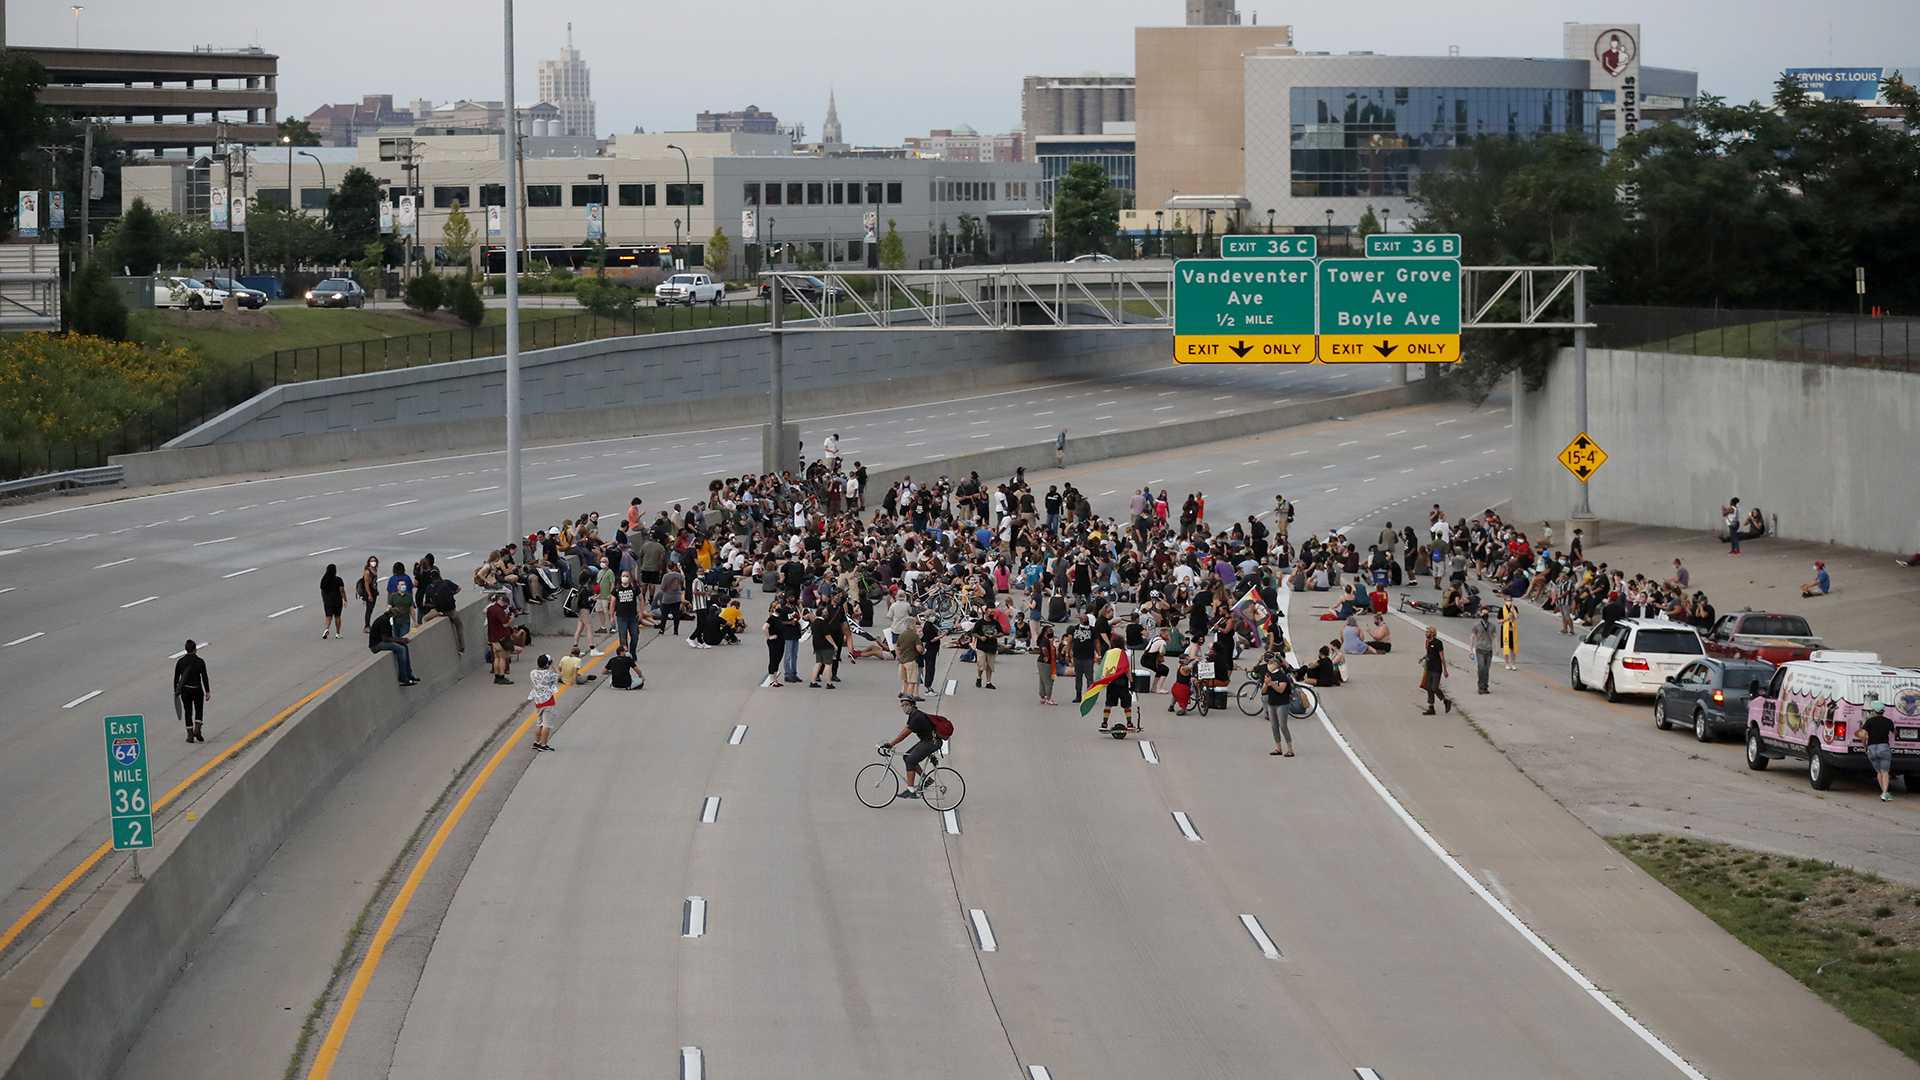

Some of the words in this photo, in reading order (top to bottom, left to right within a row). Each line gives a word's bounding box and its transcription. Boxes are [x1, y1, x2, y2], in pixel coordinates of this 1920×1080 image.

[1792, 72, 1833, 81] ERVING
[1849, 72, 1877, 81] LOUIS
[1621, 76, 1638, 134] spitals
[1230, 242, 1257, 252] EXIT
[1268, 240, 1290, 254] 36
[1296, 240, 1308, 254] C
[1374, 242, 1401, 252] EXIT
[1412, 240, 1436, 253] 36
[1442, 240, 1454, 253] B
[1182, 269, 1308, 284] Vandeventer
[1327, 268, 1385, 283] Tower
[1396, 268, 1452, 282] Grove
[1227, 291, 1263, 305] Ave
[1371, 289, 1408, 304] Ave
[1245, 314, 1273, 325] MILE
[1338, 311, 1393, 329] Boyle
[1404, 311, 1441, 325] Ave
[1188, 344, 1219, 355] EXIT
[1263, 344, 1301, 355] ONLY
[1332, 344, 1364, 355] EXIT
[1407, 343, 1445, 354] ONLY
[110, 721, 139, 735] EAST
[115, 745, 137, 761] 64
[113, 769, 143, 783] MILE
[115, 789, 145, 813] 36
[124, 821, 143, 845] .2
